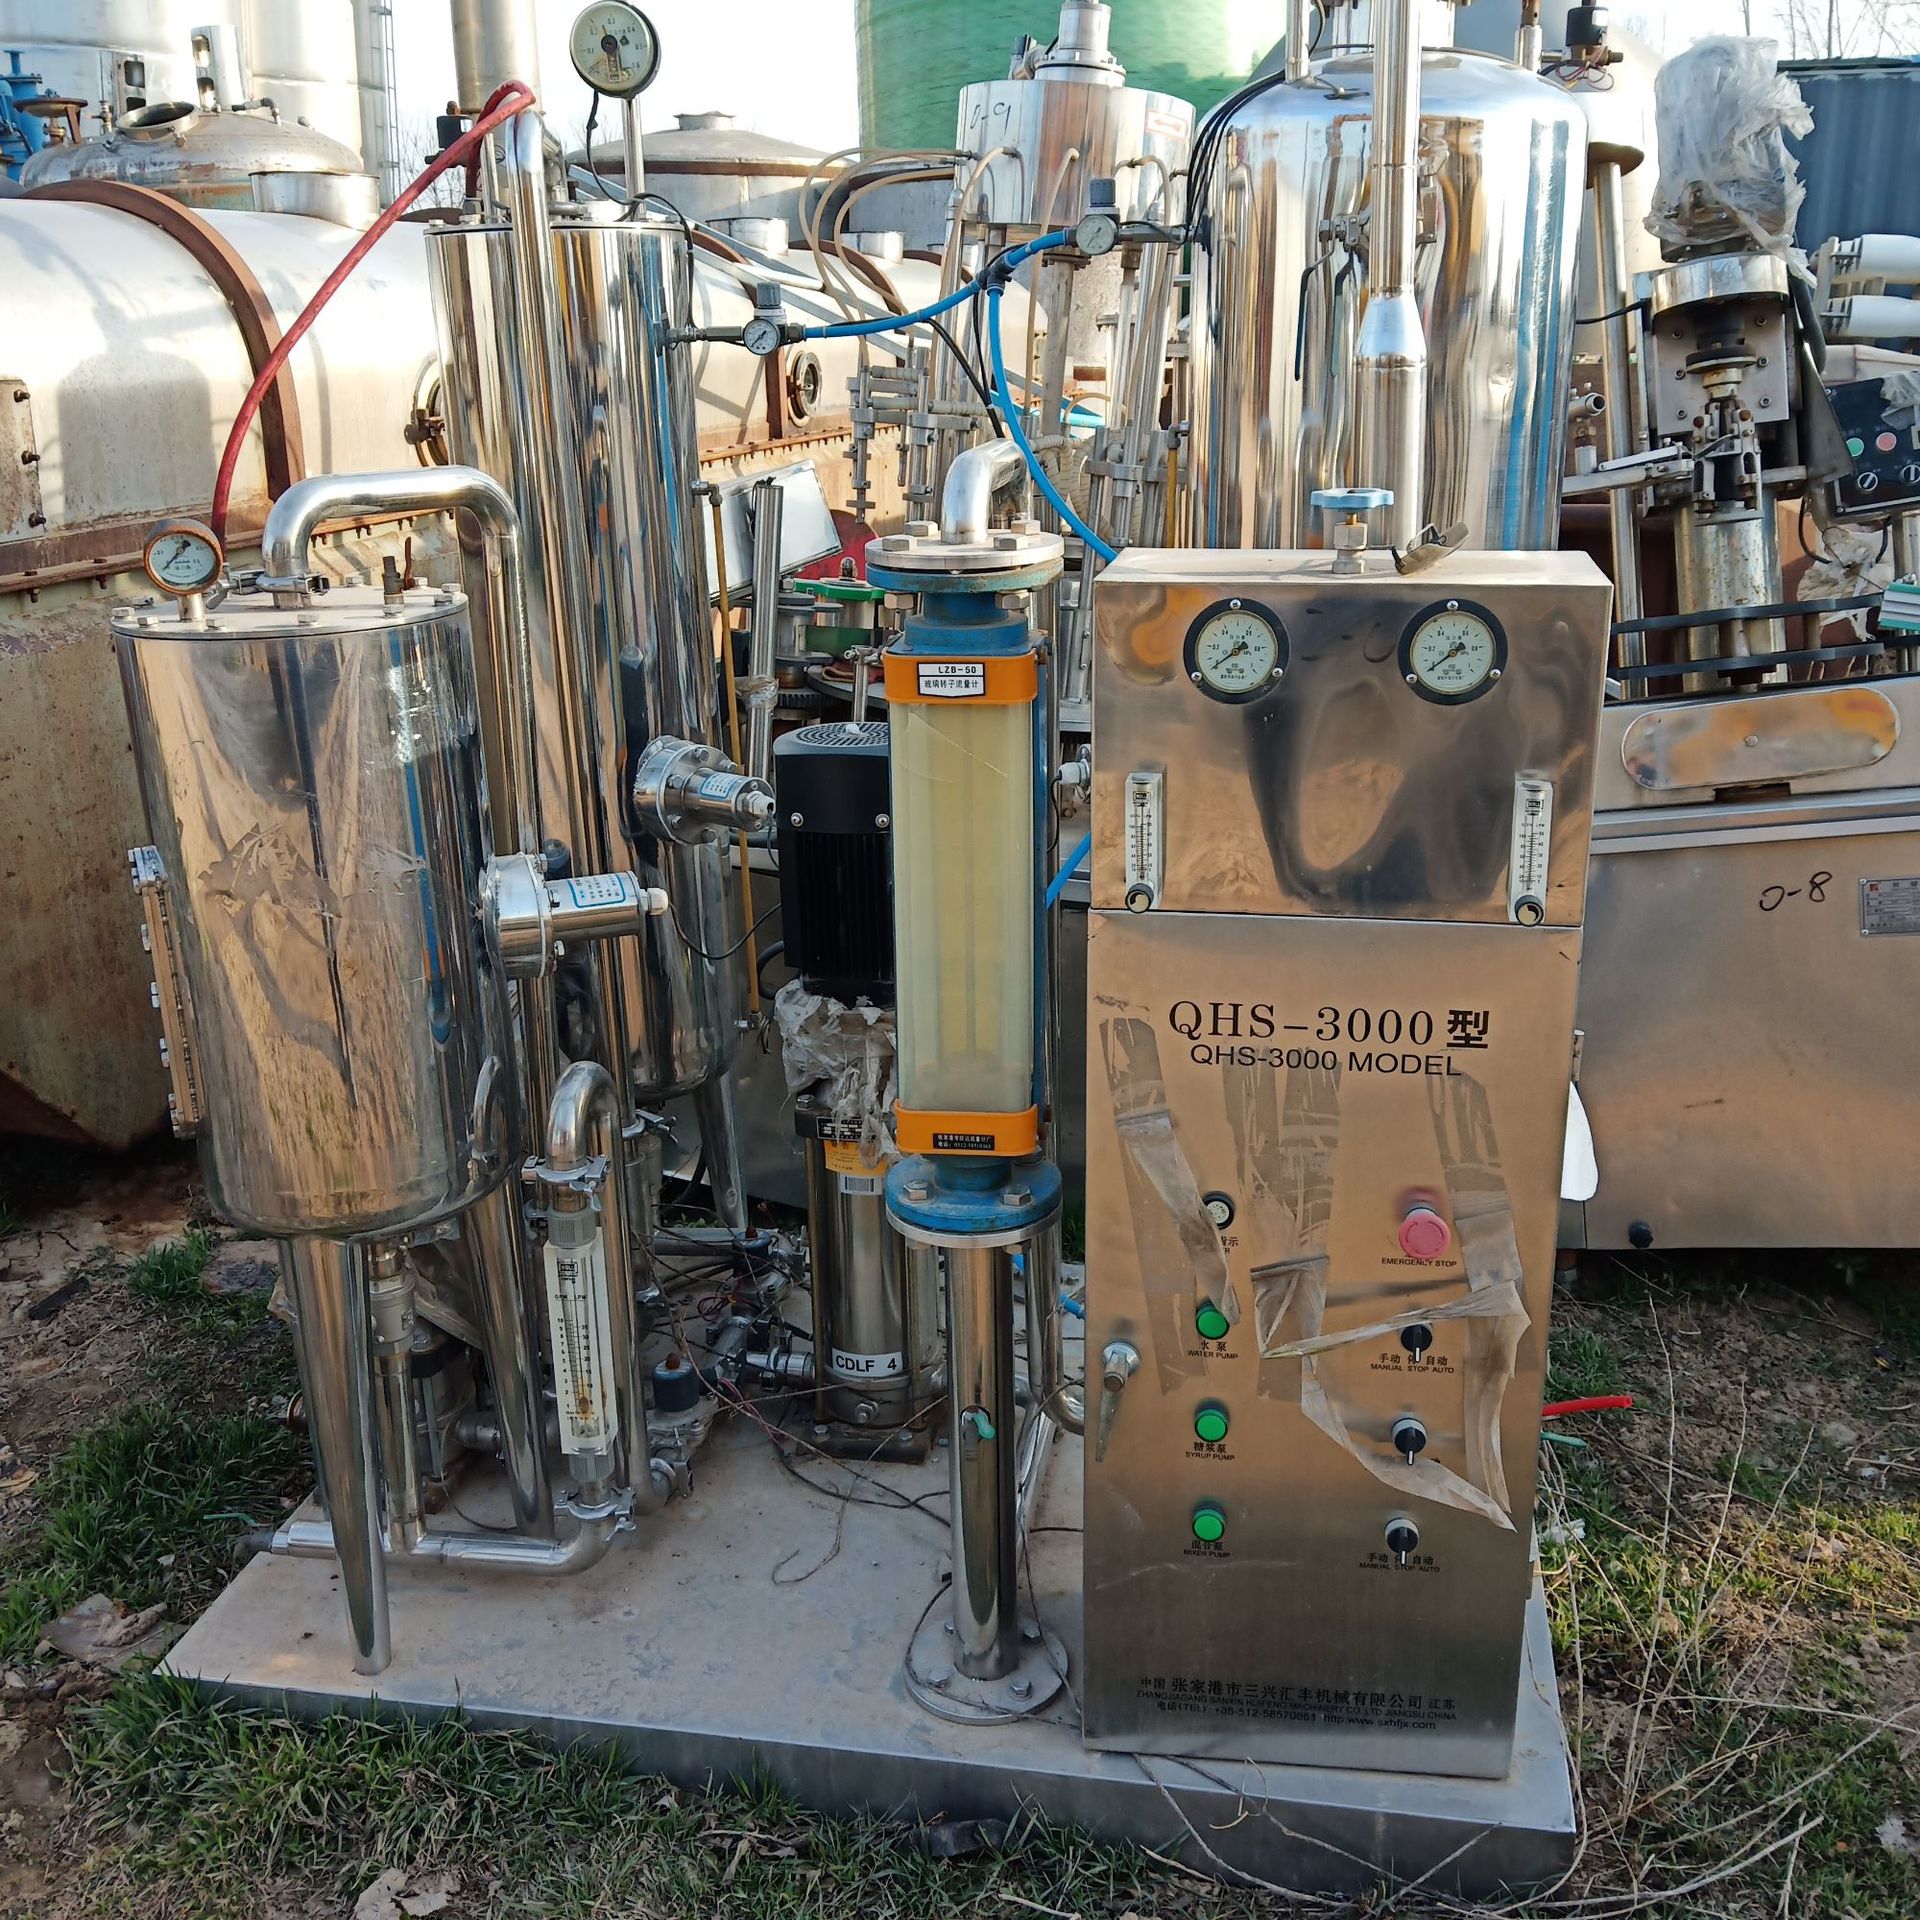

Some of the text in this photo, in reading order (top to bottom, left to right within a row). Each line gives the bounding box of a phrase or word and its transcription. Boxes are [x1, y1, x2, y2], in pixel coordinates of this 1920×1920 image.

[938, 666, 977, 674] LZB-50
[1169, 1001, 1490, 1049] QHS-3000 型
[1191, 1044, 1462, 1076] QHS-3000 MODEL
[1381, 1257, 1433, 1266] EMERGENCY
[1188, 1350, 1214, 1358] WATER
[836, 1355, 897, 1372] CDLF 4
[1379, 1353, 1401, 1364] 手动
[1426, 1355, 1448, 1366] 自动
[1371, 1363, 1403, 1371] MANUAL
[1408, 1365, 1429, 1373] STOP
[1185, 1451, 1235, 1461] SYRUP PUMP
[1209, 1550, 1231, 1558] PUMP
[1367, 1552, 1388, 1563] 手动
[1413, 1555, 1434, 1565] 自动
[1360, 1562, 1391, 1570] MANUAL
[1141, 1677, 1166, 1690] 中国
[1429, 1698, 1455, 1710] 江苏
[1427, 1711, 1457, 1720] CHINA
